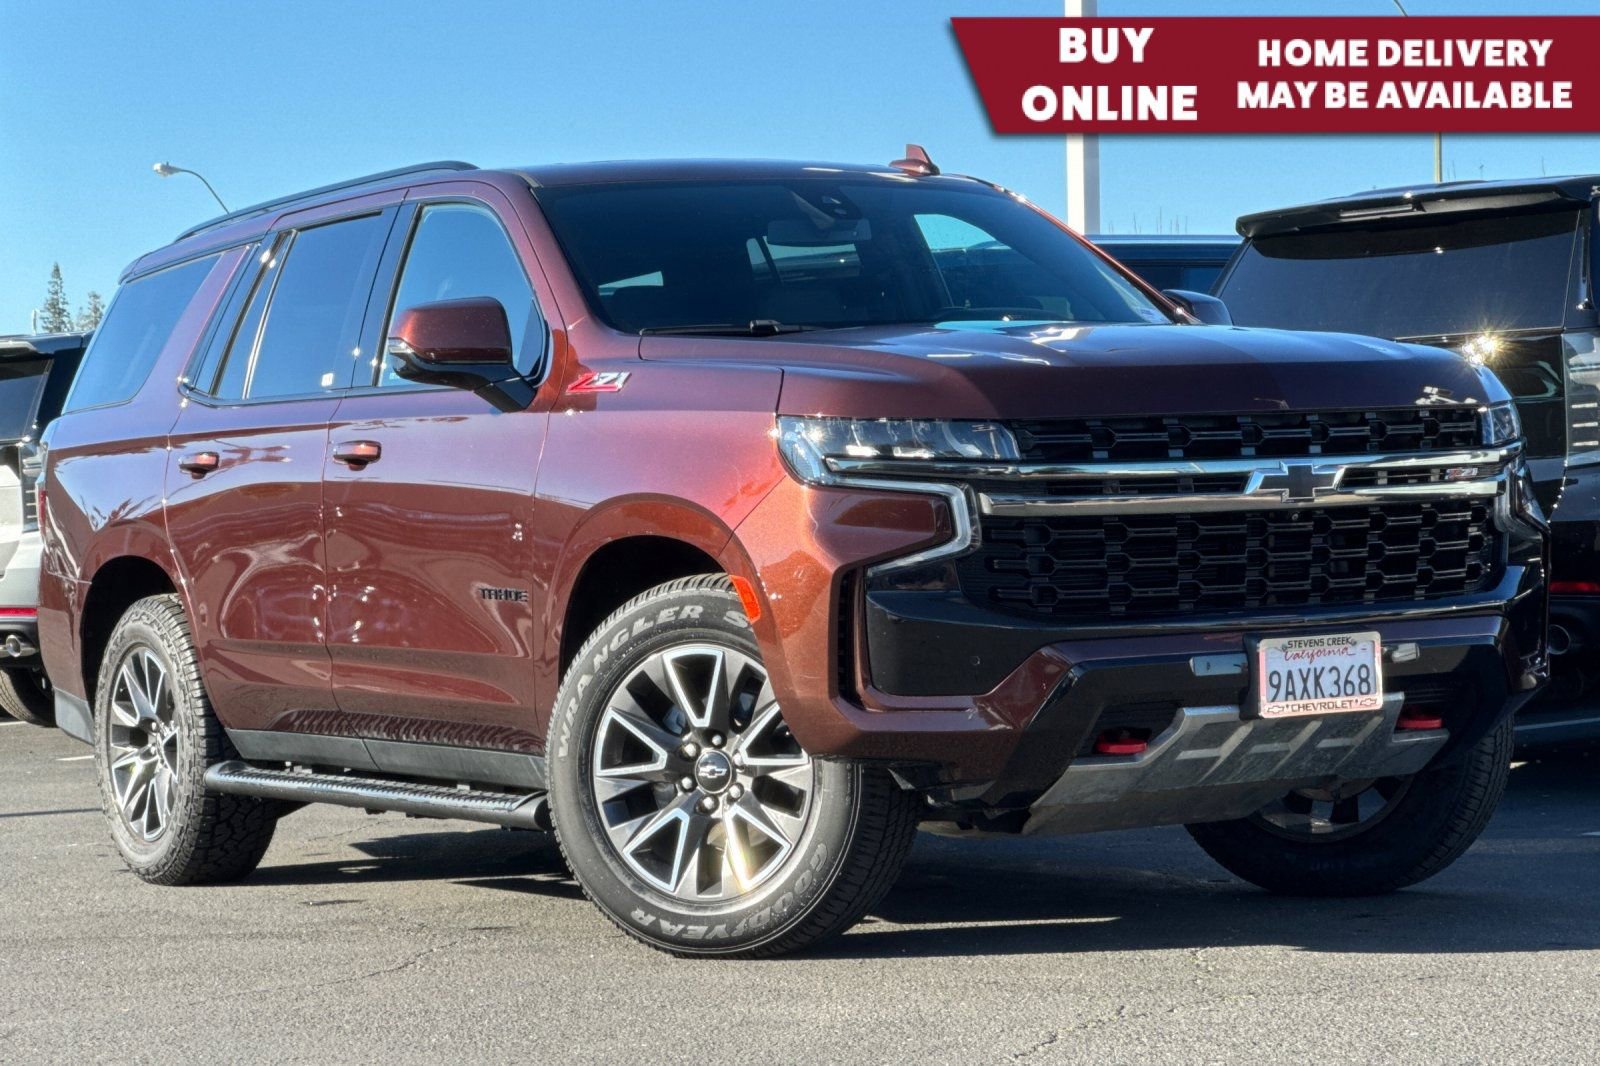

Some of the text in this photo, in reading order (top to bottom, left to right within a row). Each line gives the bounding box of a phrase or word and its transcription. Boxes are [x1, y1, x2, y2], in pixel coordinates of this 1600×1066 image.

[566, 371, 632, 393] Z71
[479, 588, 528, 602] TAHOE
[1287, 636, 1353, 649] STEVENS CREEK
[1284, 646, 1356, 664] California
[558, 605, 703, 758] WRANGLER
[1268, 663, 1371, 703] 9AXK368
[1290, 700, 1354, 713] CHEVROLET
[630, 842, 828, 940] GOODYEAR
